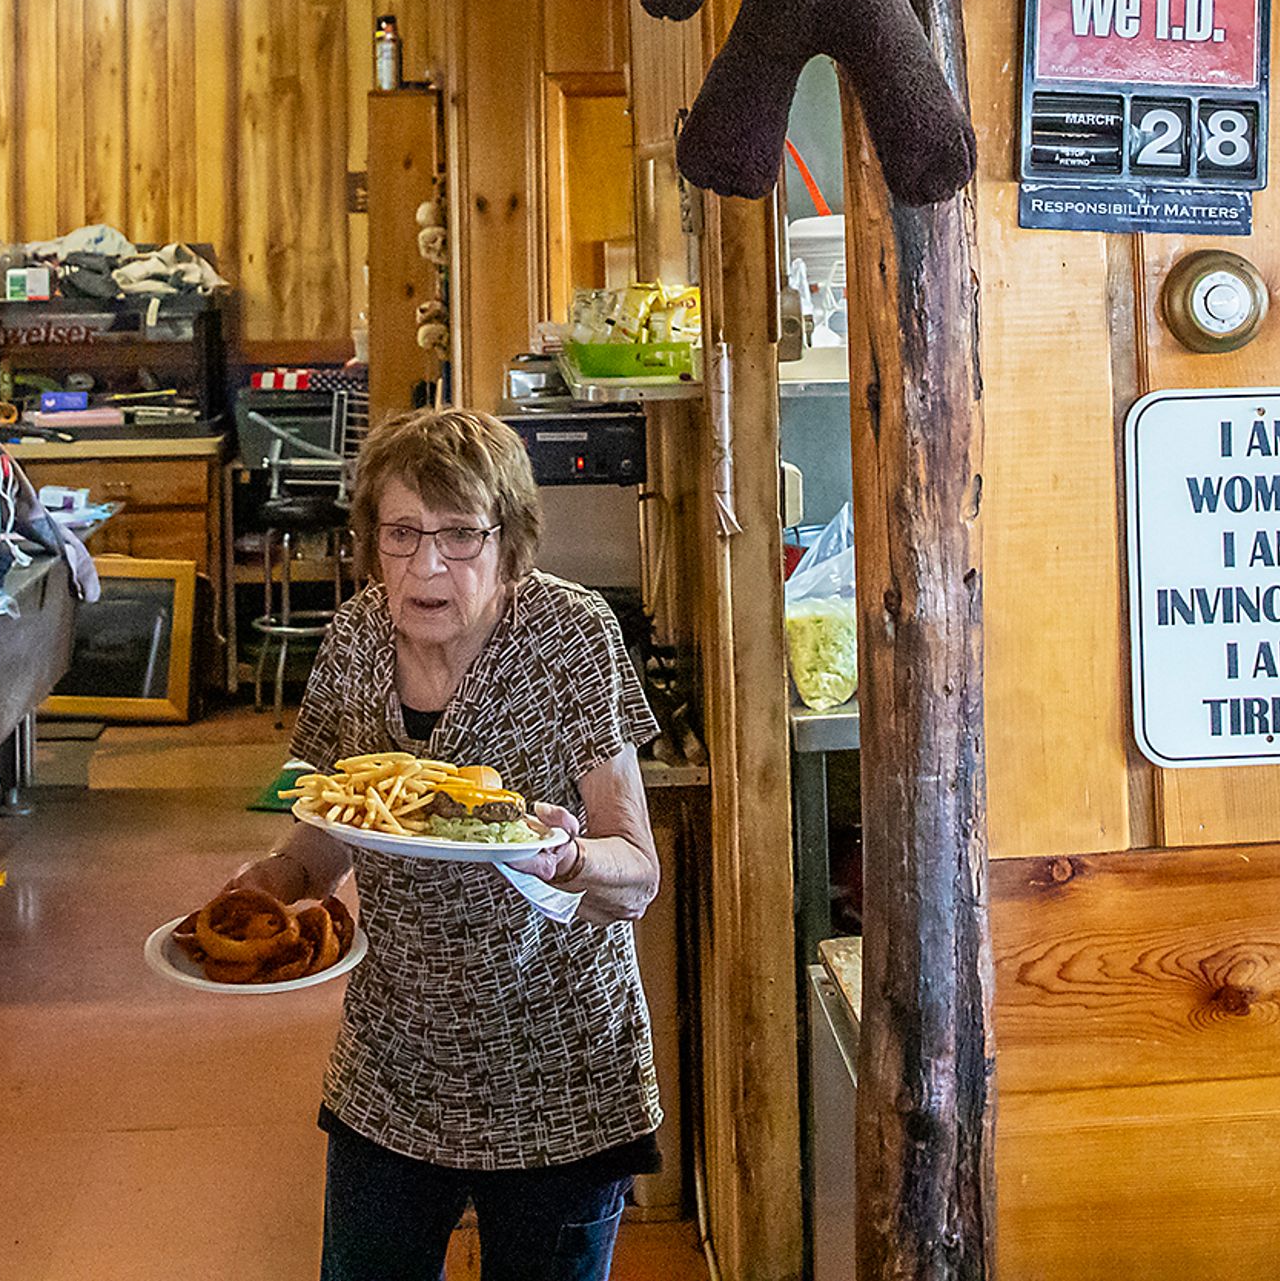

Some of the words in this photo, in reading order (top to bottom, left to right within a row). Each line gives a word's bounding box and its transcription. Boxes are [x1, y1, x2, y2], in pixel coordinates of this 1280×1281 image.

[1065, 113, 1115, 125] MARCH
[1031, 199, 1160, 217] RESPONSIBILITY
[1164, 203, 1239, 219] MATTERS
[1220, 421, 1233, 458] I
[1223, 530, 1236, 568] I
[1226, 641, 1239, 680] I
